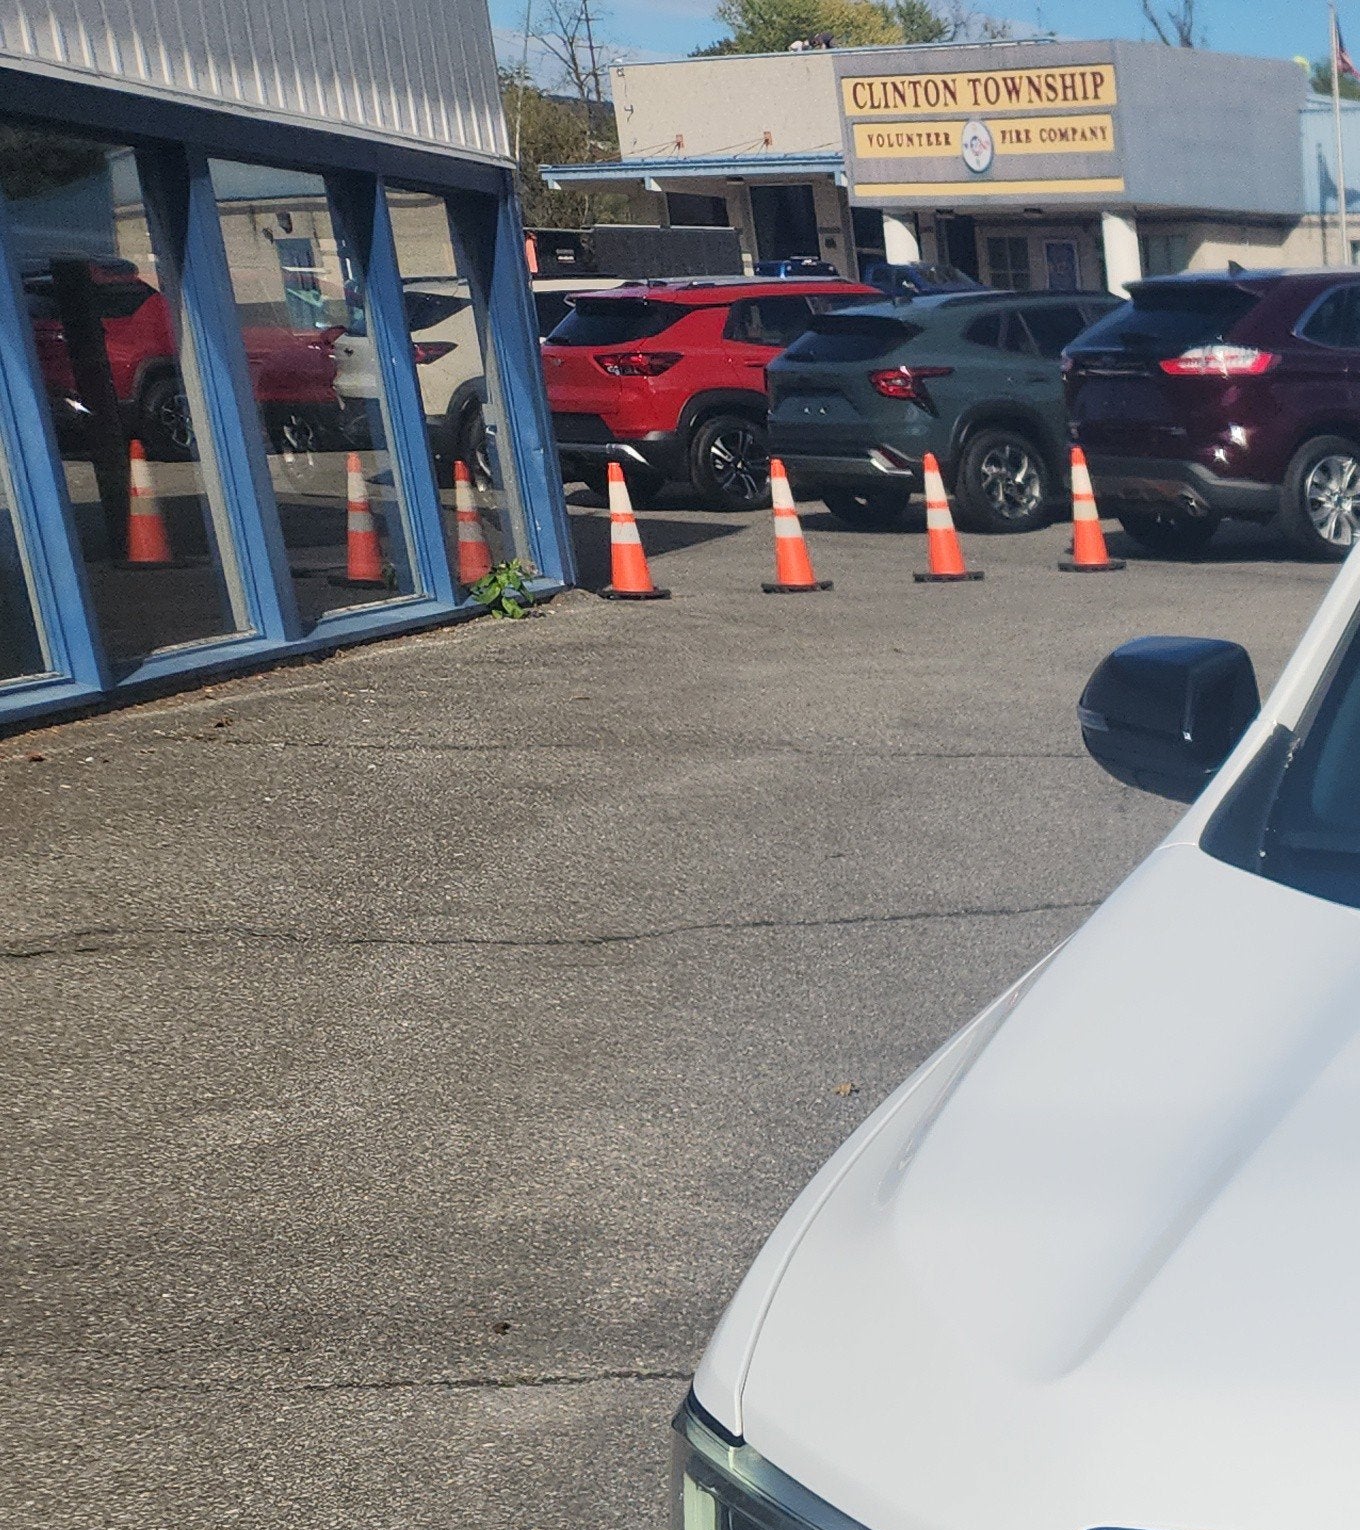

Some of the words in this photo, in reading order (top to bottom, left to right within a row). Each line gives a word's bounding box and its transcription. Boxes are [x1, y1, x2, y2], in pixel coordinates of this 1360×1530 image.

[852, 78, 958, 110] CLINTON
[967, 71, 1105, 106] TOWNSHIP
[867, 131, 952, 148] VOLUNTEER
[1000, 129, 1032, 145] FIRE
[1039, 125, 1108, 143] COMPANY
